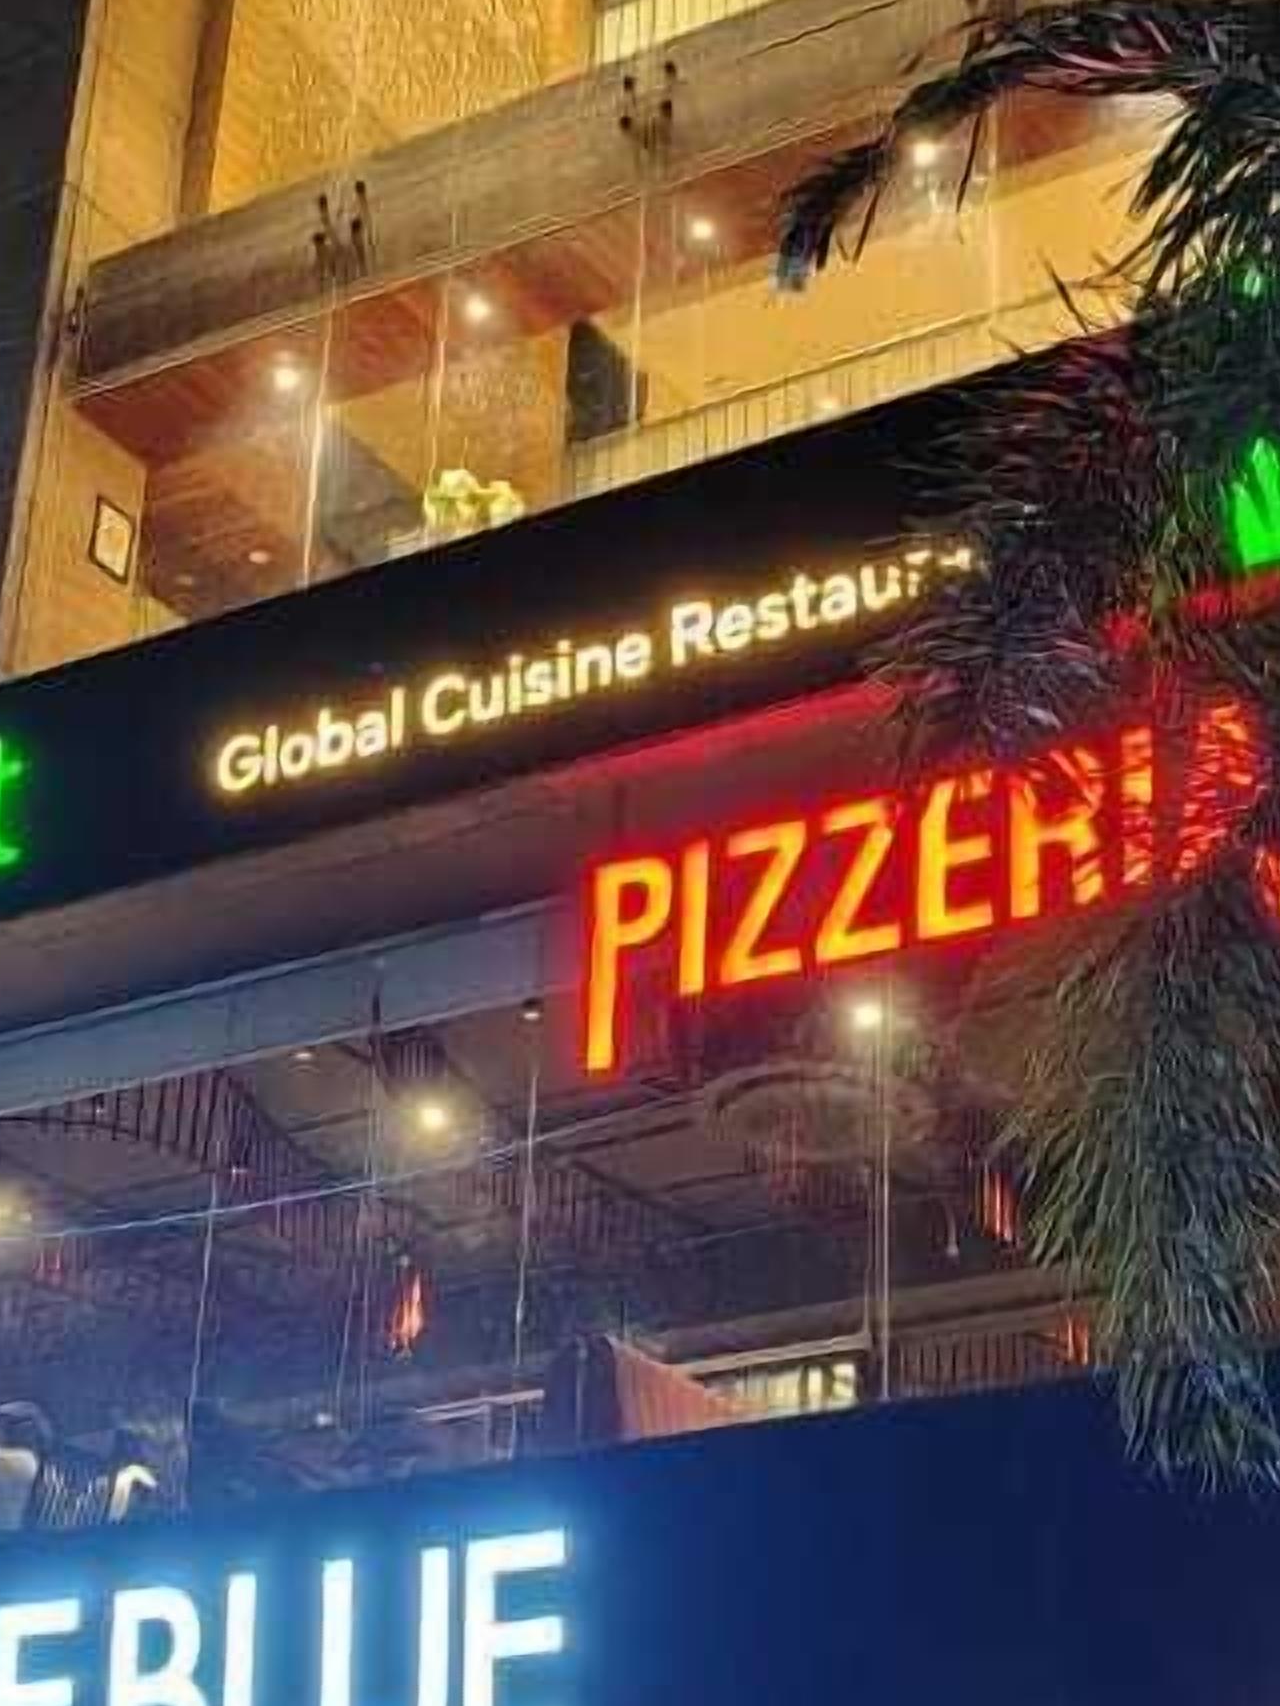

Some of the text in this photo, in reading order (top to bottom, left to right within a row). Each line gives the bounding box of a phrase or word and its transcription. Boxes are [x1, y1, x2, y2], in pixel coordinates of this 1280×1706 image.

[218, 546, 974, 792] Global Cuisine Restaur
